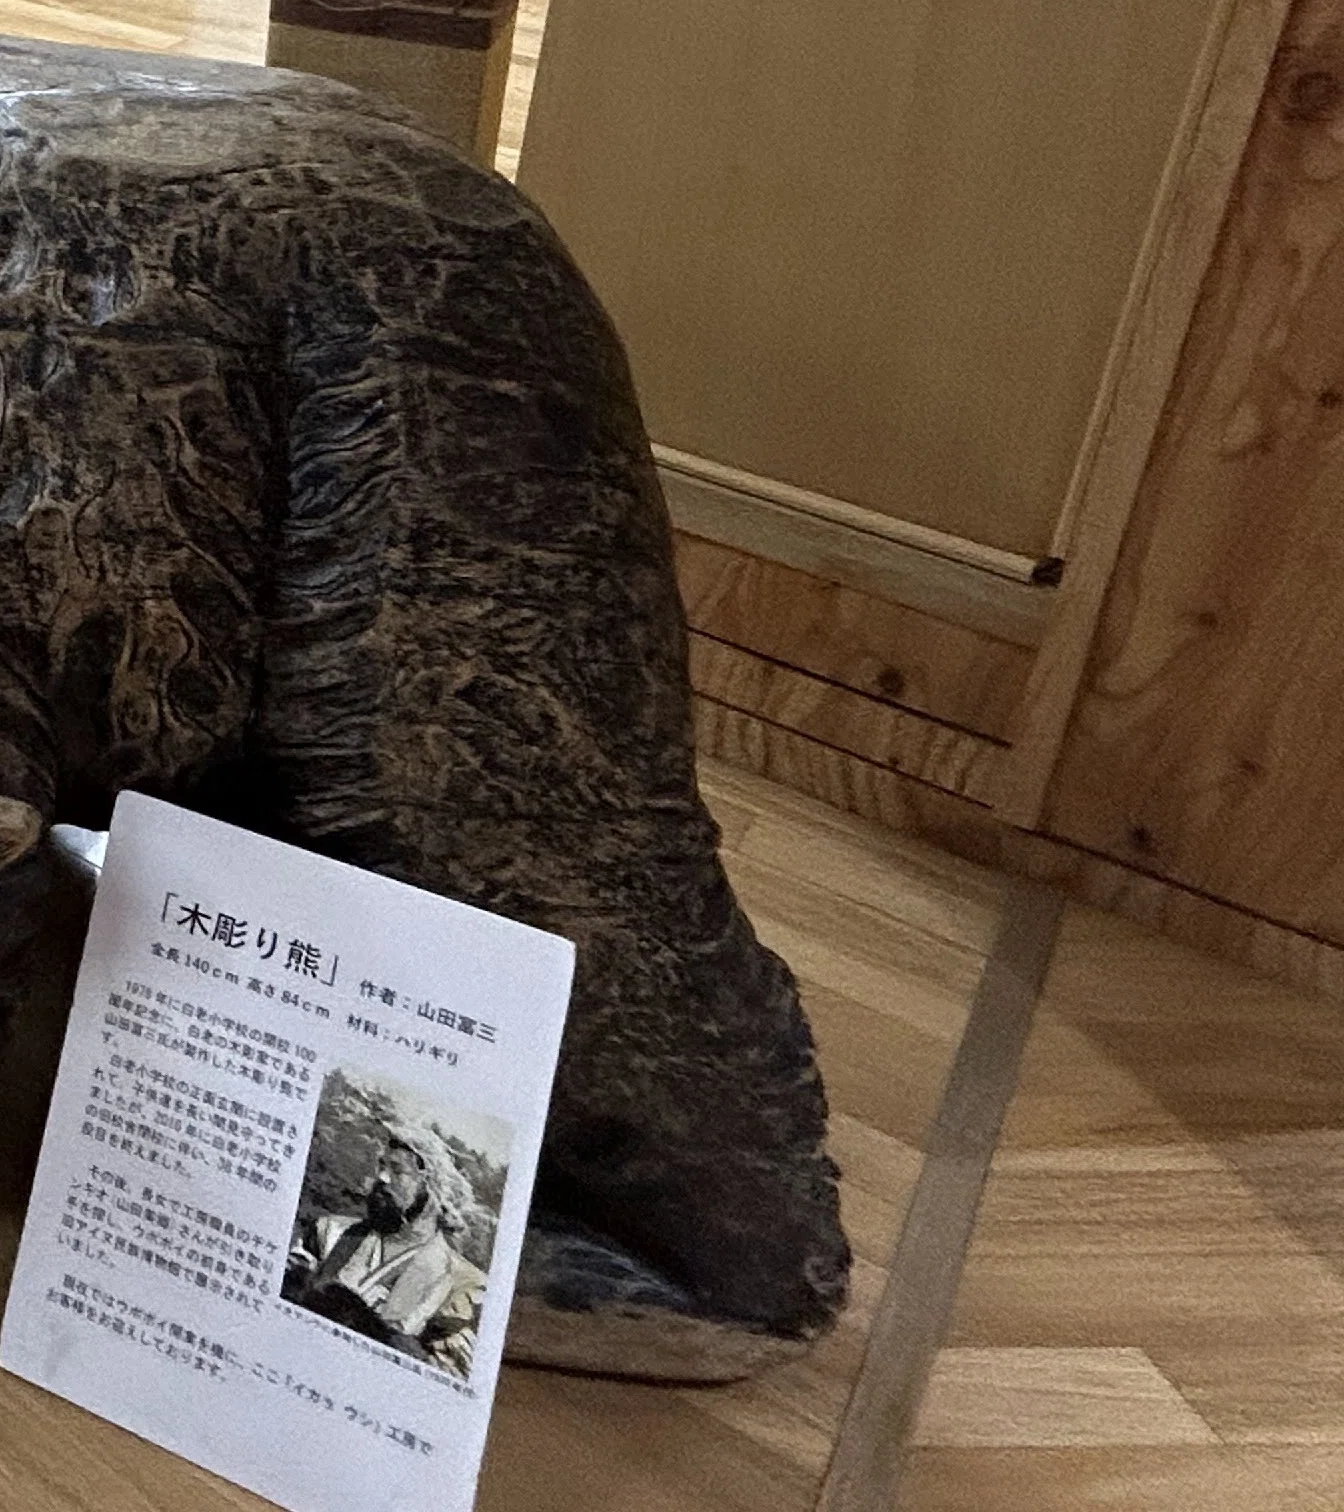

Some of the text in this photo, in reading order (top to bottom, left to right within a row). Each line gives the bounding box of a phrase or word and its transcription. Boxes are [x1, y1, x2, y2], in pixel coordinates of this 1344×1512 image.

[160, 891, 497, 1044] 「木彫り熊」 作者：山田富三
